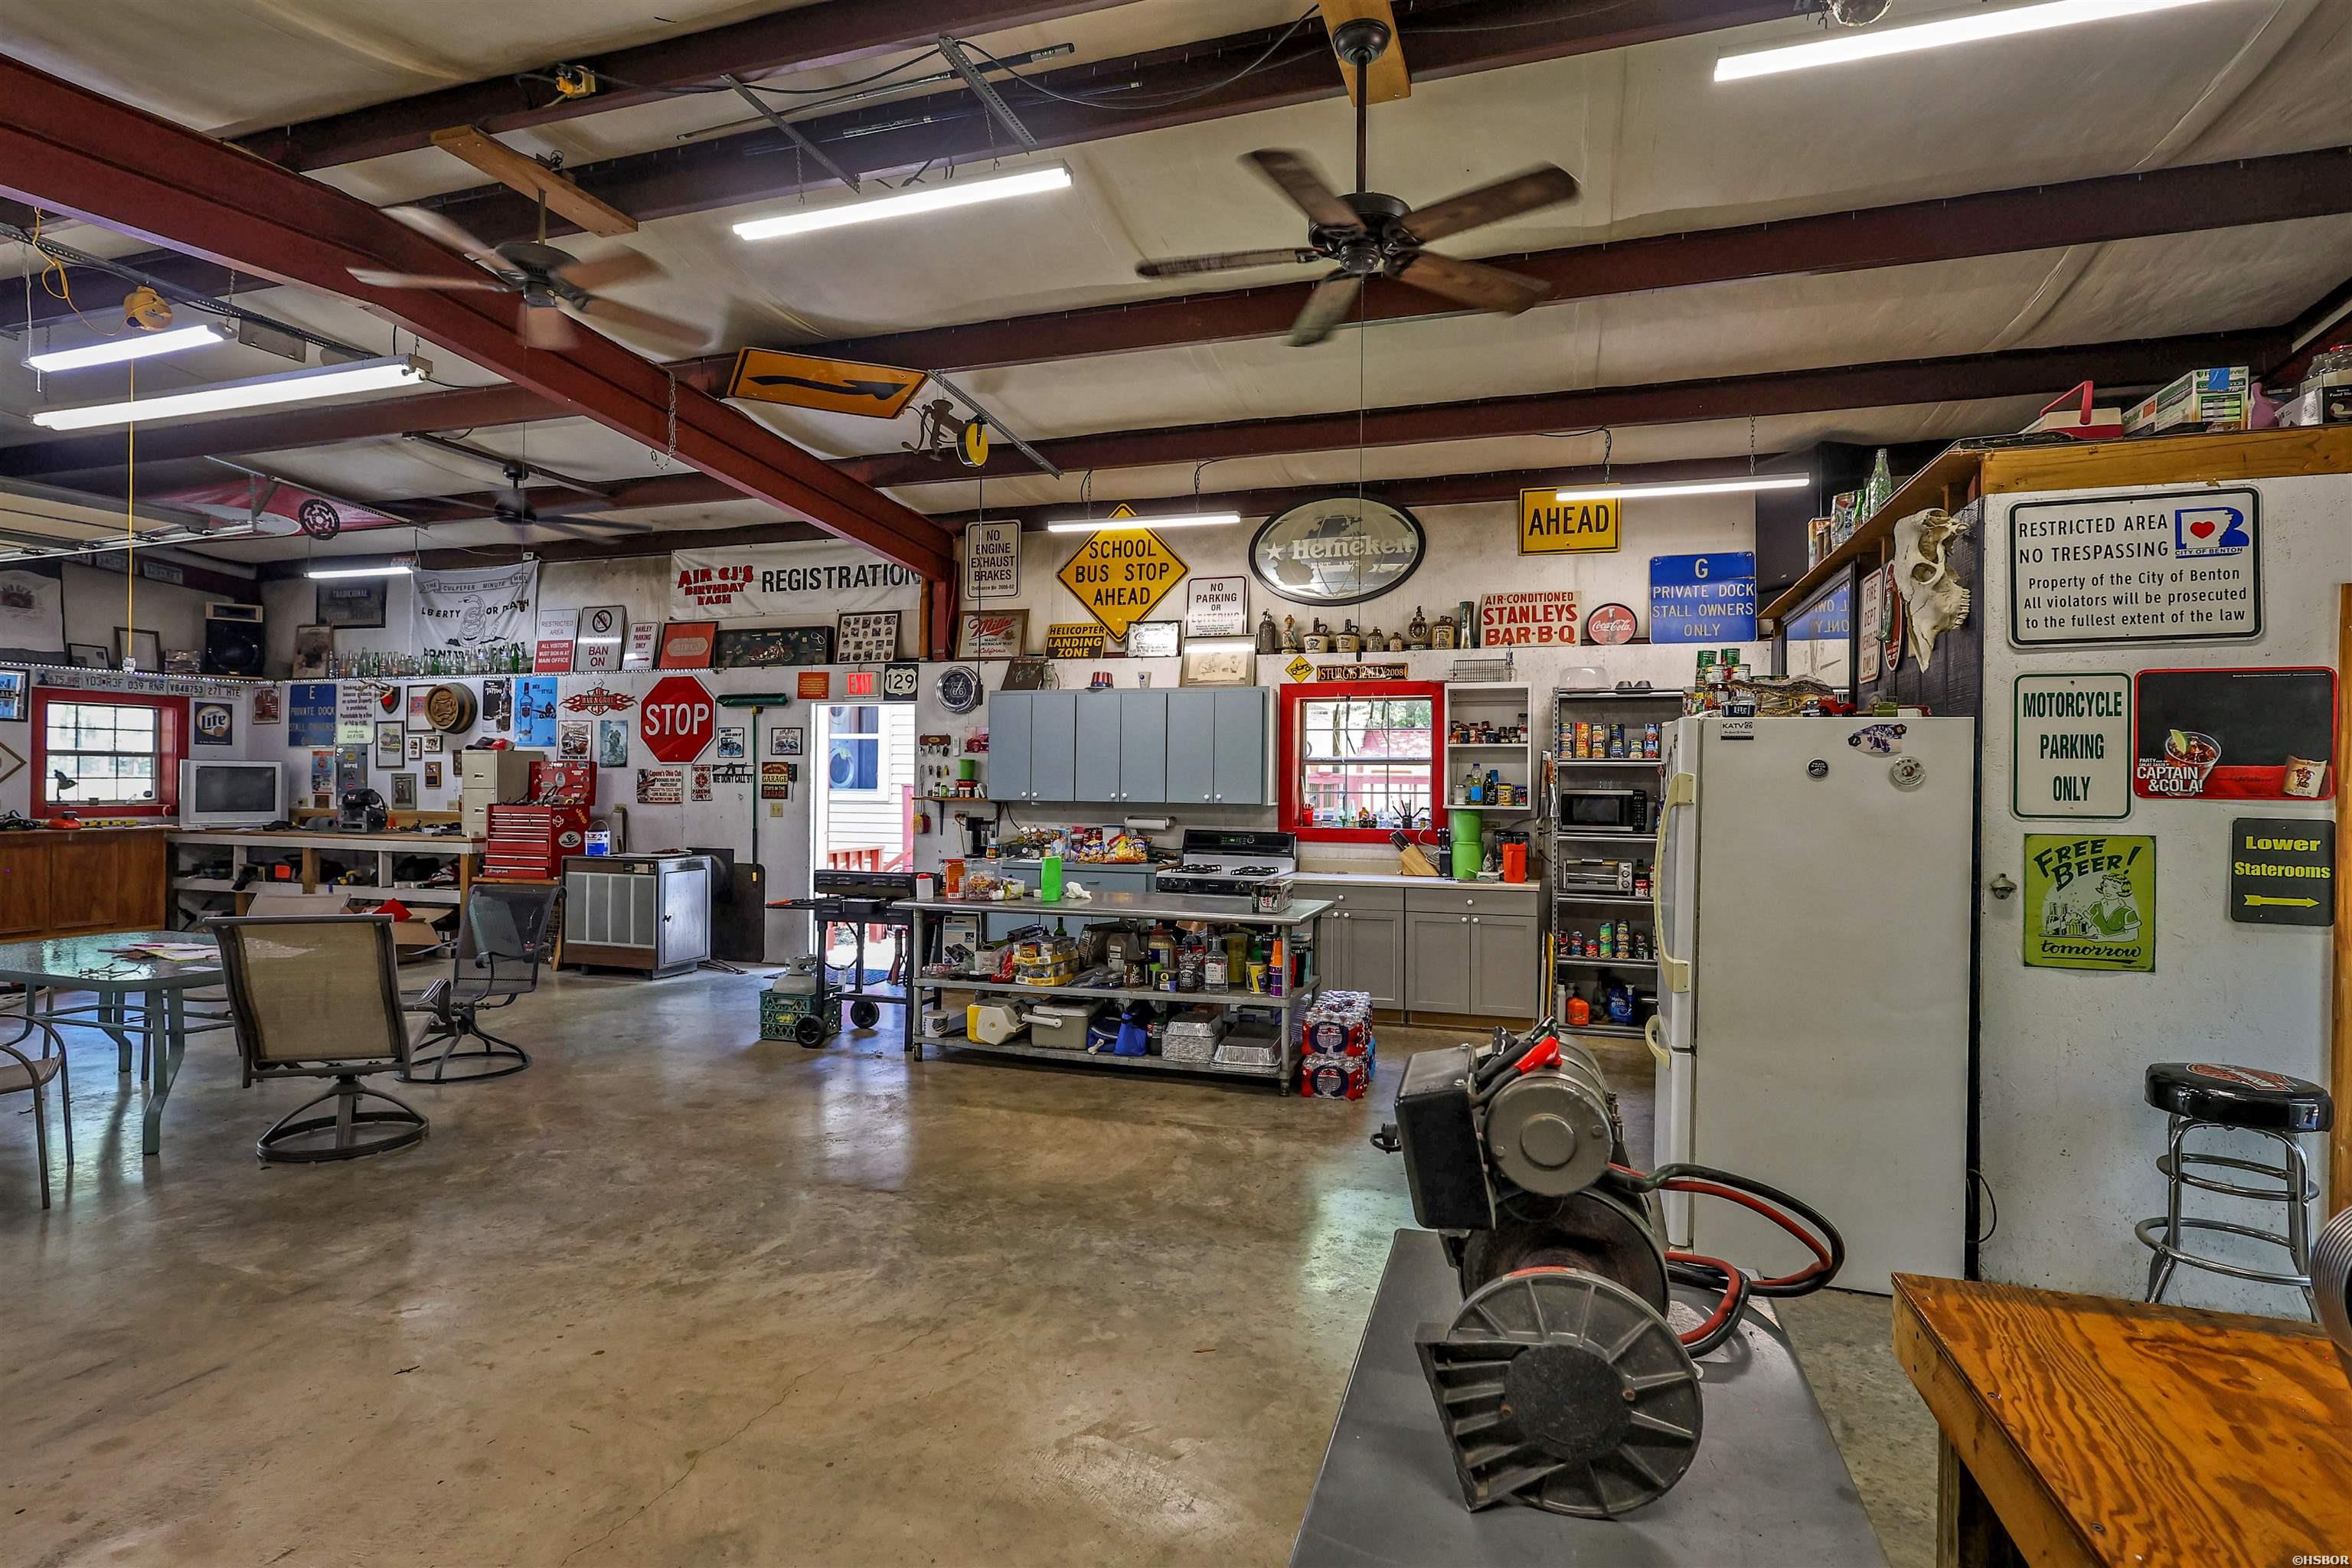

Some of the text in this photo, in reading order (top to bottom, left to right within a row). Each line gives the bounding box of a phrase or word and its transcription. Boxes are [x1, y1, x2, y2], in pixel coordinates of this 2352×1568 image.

[1528, 505, 1609, 536] AHEAD
[2019, 514, 2168, 537] RESTRICTED AREA
[986, 529, 1001, 541] NO
[975, 542, 1011, 555] ENGINE
[1089, 539, 1157, 559] SCHOOL
[1292, 533, 1413, 560] Heineken
[2019, 541, 2169, 564] NO TRESPASSING
[971, 555, 1015, 568] EXHAUST
[1694, 557, 1709, 579] G
[678, 565, 754, 589] AIR CJ'S
[761, 563, 921, 593] REGISTRATION
[974, 569, 1012, 581] BRAKES
[1075, 563, 1170, 583] BUS STOP
[2029, 567, 2240, 591] Property of the City of Benton
[684, 582, 746, 596] BIRTHDAY
[1093, 587, 1151, 606] AHEAD
[1210, 583, 1223, 592] NO
[1653, 583, 1755, 599] PRIVATE DOCK
[1866, 583, 1877, 605] FIRE
[1196, 593, 1237, 603] PARKING
[1485, 592, 1574, 606] AIR-CONDITIONED
[2024, 587, 2247, 609] All violators will be prosecuted
[421, 606, 499, 619] LBERTY OR
[1482, 603, 1578, 626] STANLEYS
[1652, 602, 1753, 618] STALL OWNERS
[1864, 607, 1877, 628] DEPT.
[2025, 608, 2245, 629] to the fullest extent of the law
[968, 616, 1018, 639] Miller
[1049, 626, 1105, 635] HELICOPTER
[1485, 625, 1577, 646] BAR-B-Q
[1684, 623, 1721, 638] ONLY
[588, 645, 609, 656] BAN
[1047, 637, 1102, 648] LANDING
[590, 656, 606, 667] ON
[1057, 648, 1089, 658] ZONE
[1862, 654, 1875, 673] ONLY
[848, 673, 873, 694] EXIT
[886, 674, 915, 690] 129
[1320, 667, 1357, 681] STURGIS
[1386, 668, 1404, 677] 2008
[309, 685, 315, 700] E
[952, 688, 965, 697] 66
[290, 707, 335, 717] PRIVATE DOCK
[2023, 691, 2122, 718] MOTORCYCLE
[201, 713, 227, 730] Lite
[644, 703, 710, 737] STOP
[2039, 733, 2105, 760] PARKING
[713, 775, 720, 783] WE
[2137, 766, 2198, 780] CAPTAIN
[2052, 776, 2091, 802] ONLY
[2148, 779, 2204, 793] &COLA!
[2244, 835, 2322, 853] Lower
[2034, 838, 2107, 878] FREE
[2050, 846, 2143, 892] BEER!
[2233, 861, 2332, 880] Staterooms
[2041, 939, 2142, 958] tomorrow
